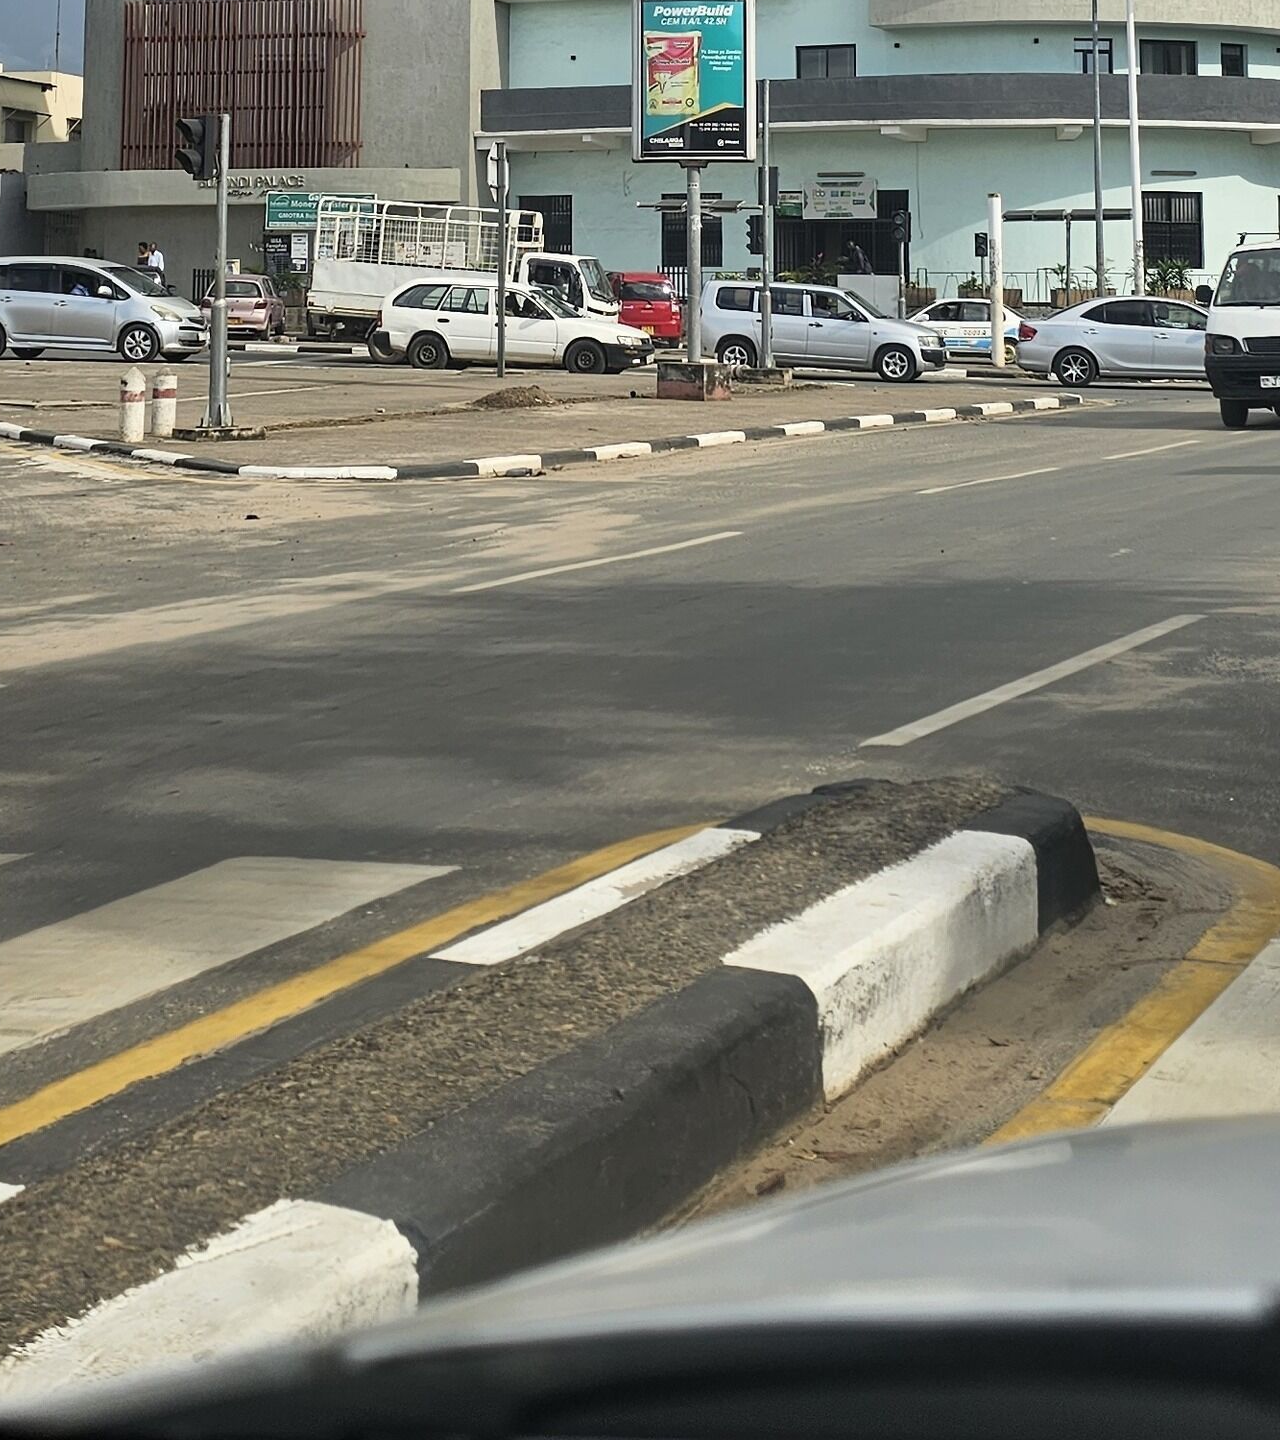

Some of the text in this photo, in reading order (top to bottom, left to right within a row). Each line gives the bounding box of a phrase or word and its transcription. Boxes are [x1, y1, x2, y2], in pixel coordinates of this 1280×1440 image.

[653, 5, 734, 17] PowerBuild
[256, 175, 305, 188] PALACE
[290, 200, 317, 209] Money
